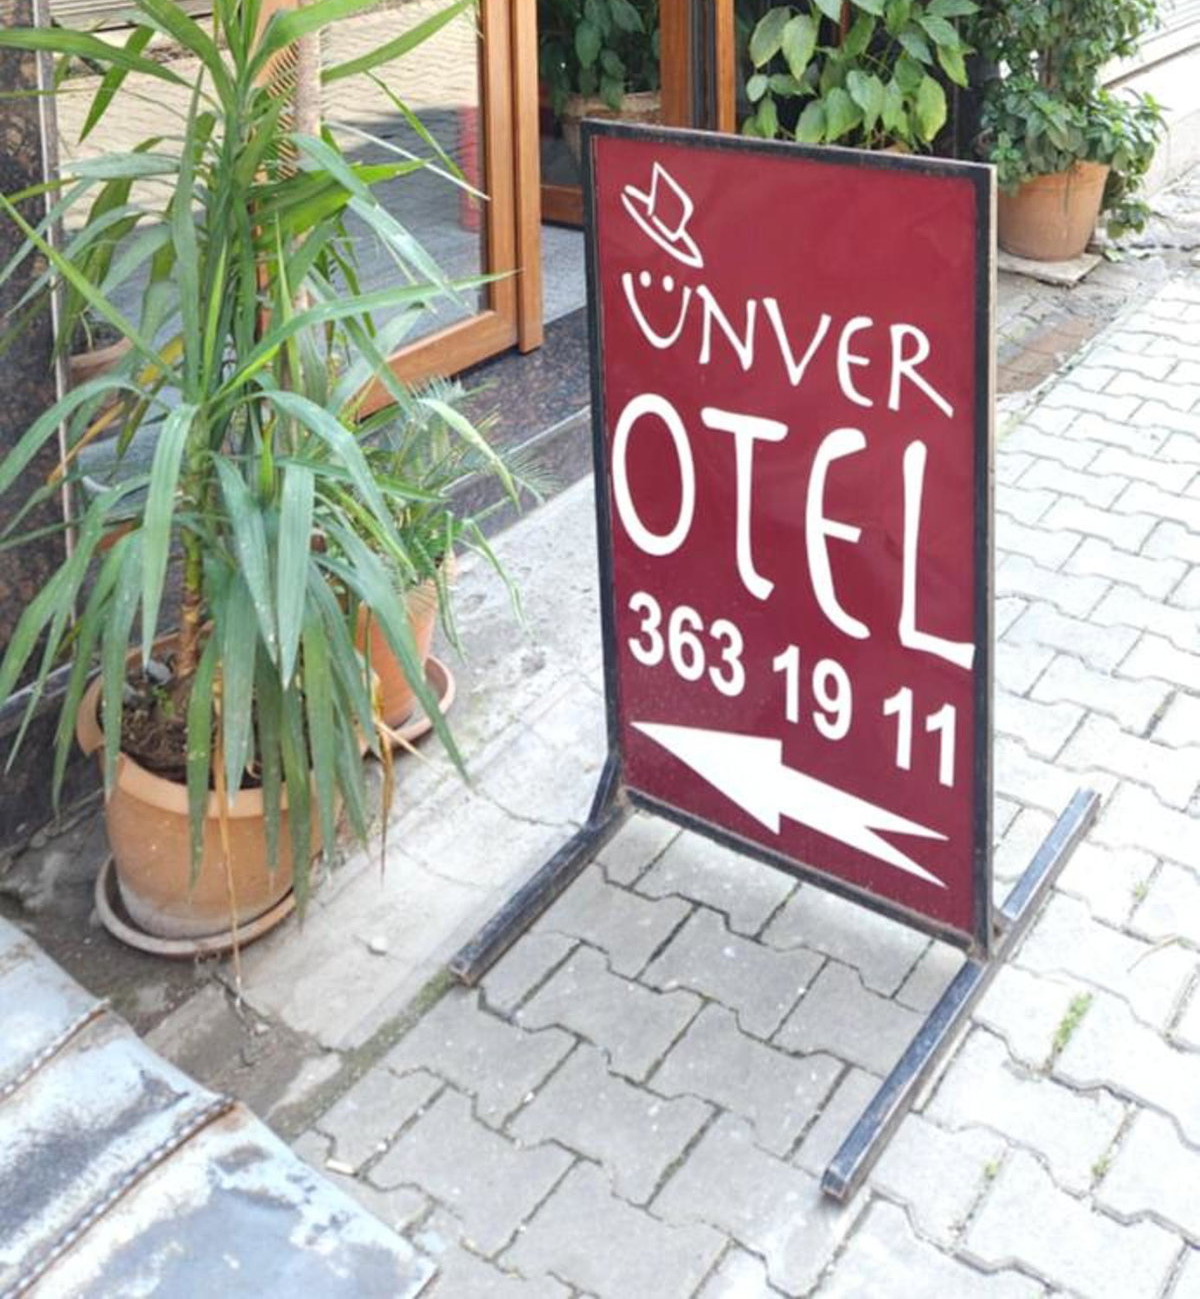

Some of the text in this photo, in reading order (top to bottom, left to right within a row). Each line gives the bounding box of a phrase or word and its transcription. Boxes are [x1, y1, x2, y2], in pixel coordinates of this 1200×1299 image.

[621, 270, 955, 418] ÜNVER
[611, 392, 976, 671] OTEL
[627, 591, 957, 787] 363 19 11
